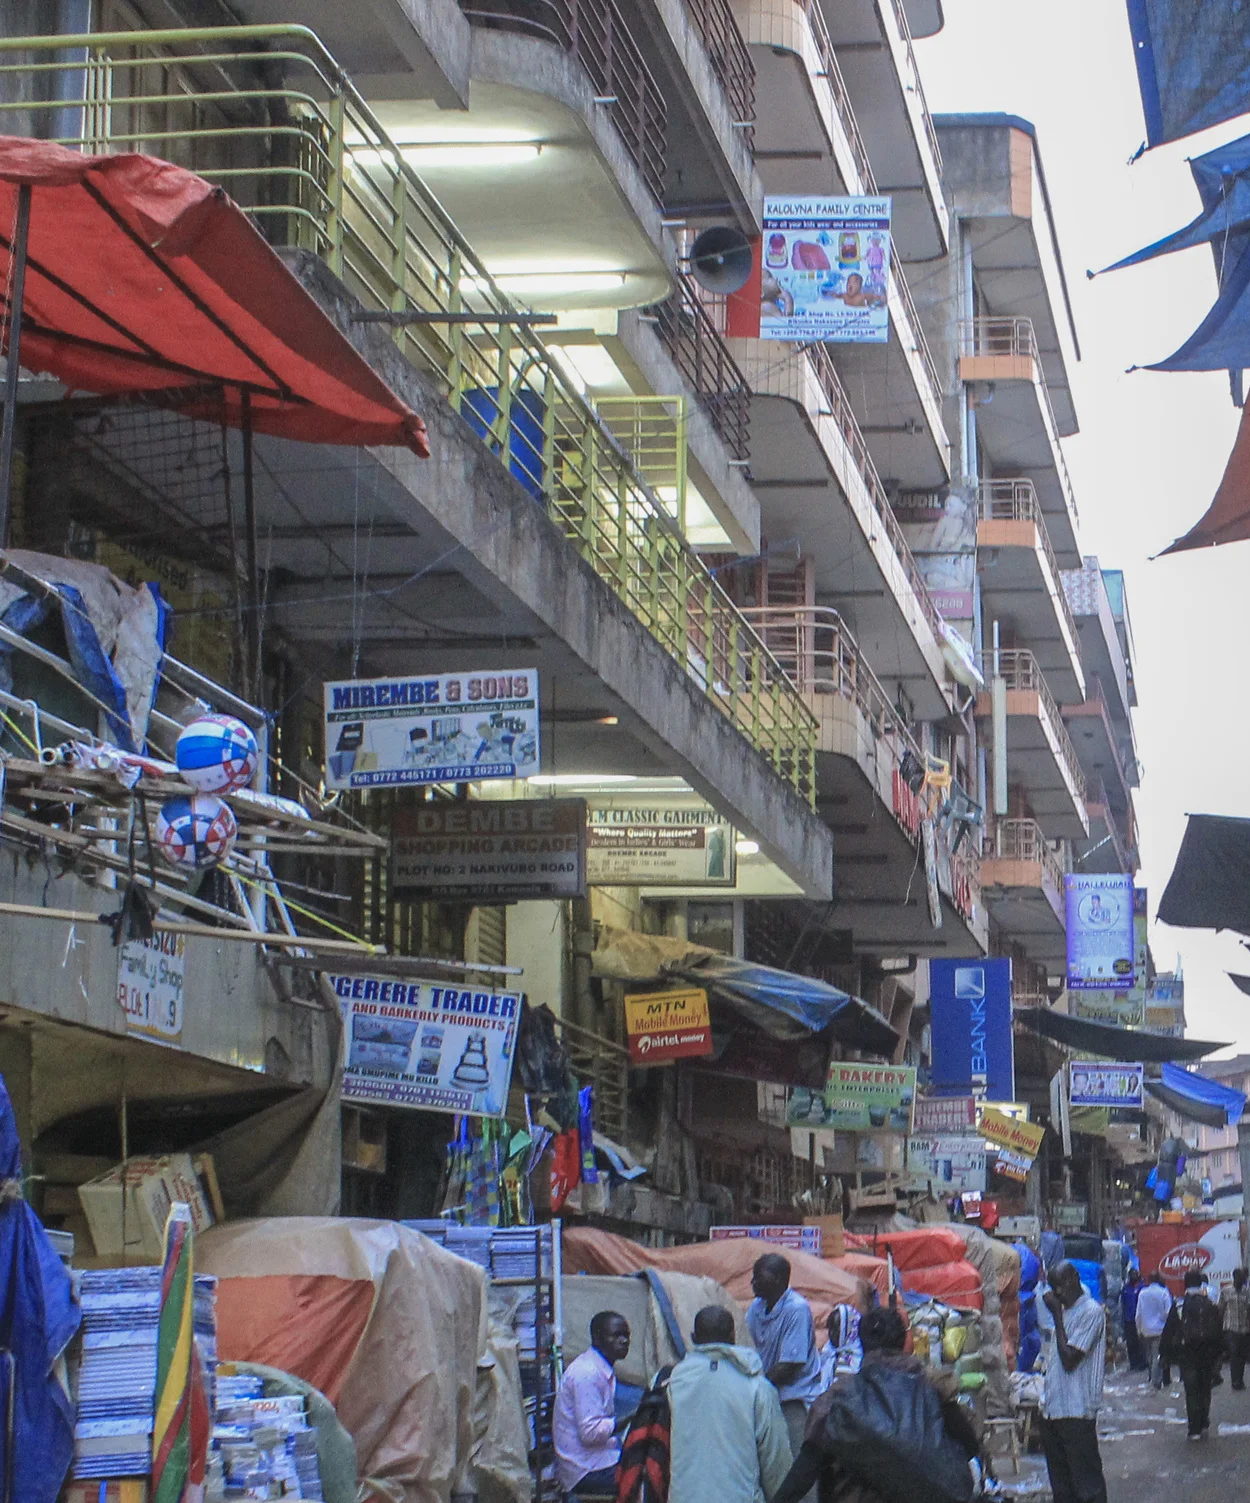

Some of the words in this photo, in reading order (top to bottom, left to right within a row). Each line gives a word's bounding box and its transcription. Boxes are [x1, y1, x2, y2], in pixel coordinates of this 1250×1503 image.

[767, 203, 813, 215] KALOLYNA
[816, 203, 849, 215] FAMILY
[853, 202, 887, 215] CENTRE
[333, 680, 440, 710] MIREMBE
[467, 675, 529, 701] SONS
[353, 775, 369, 784] Tel:
[372, 773, 397, 783] 0772
[400, 769, 438, 780] 445171
[446, 767, 471, 778] 0773
[474, 764, 512, 776] 202220
[417, 807, 554, 833] DEMBE
[612, 810, 660, 824] CLASSIC
[627, 827, 657, 839] Quality
[658, 827, 698, 838] Matters"
[397, 837, 494, 855] SHOPPING
[501, 836, 578, 853] ARCADE
[678, 839, 696, 848] Wear
[397, 864, 429, 876] PLOT
[458, 864, 466, 874] 2
[469, 864, 536, 875] NAKIVUBO
[540, 862, 575, 873] ROAD
[430, 987, 517, 1018] TRADER
[646, 1000, 686, 1015] MTN
[352, 1002, 377, 1014] AND
[441, 1012, 506, 1032] PRODUCTS
[635, 1015, 668, 1031] Mobile
[669, 1013, 702, 1027] Money
[651, 1034, 679, 1048] airtel
[971, 997, 987, 1073] BANK
[840, 1068, 907, 1085] BAKERY
[982, 1117, 1010, 1139] Mobile
[1011, 1130, 1039, 1151] Money
